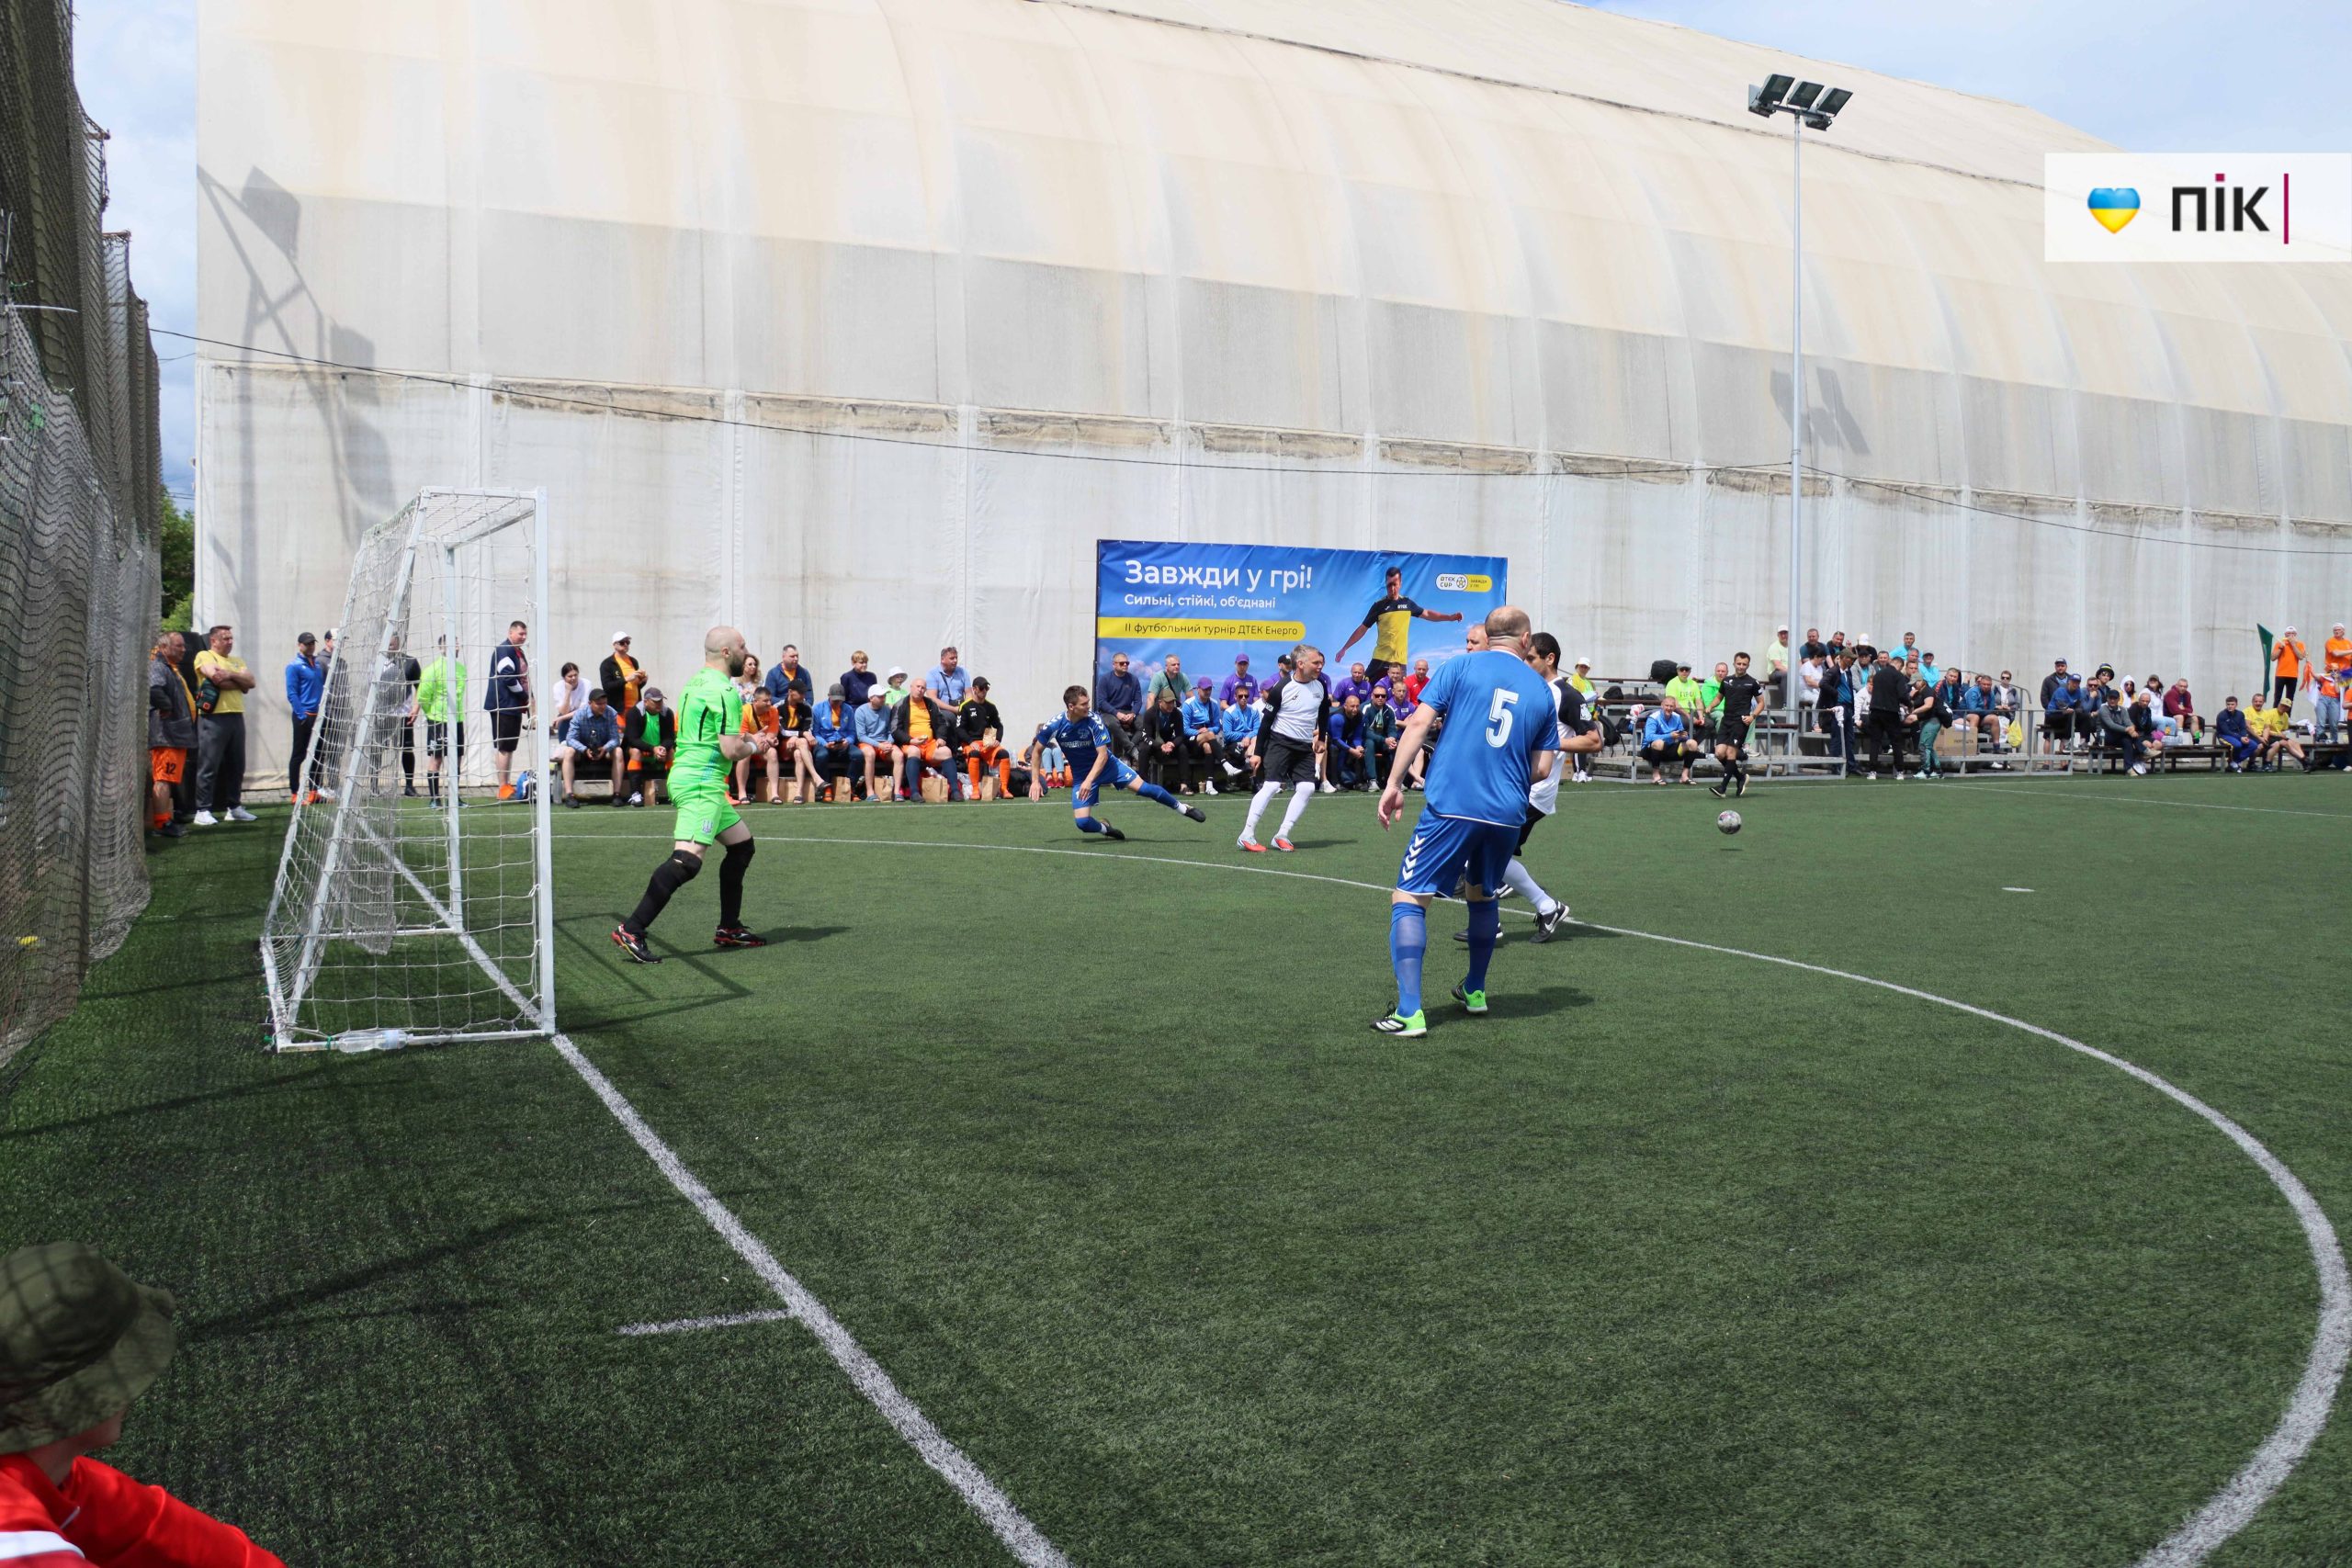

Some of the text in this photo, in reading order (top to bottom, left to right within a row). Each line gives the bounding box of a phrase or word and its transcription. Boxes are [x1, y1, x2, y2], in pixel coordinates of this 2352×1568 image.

[1125, 559, 1312, 594] Завжди у грі!
[1124, 593, 1276, 609] Сильні, стійкі, об'єднані
[1134, 622, 1201, 635] футбольний
[1203, 624, 1237, 636] турнір
[1238, 625, 1263, 636] ДТЕК
[1265, 626, 1298, 637] Енерго
[1485, 687, 1520, 749] 5
[165, 761, 176, 774] 12
